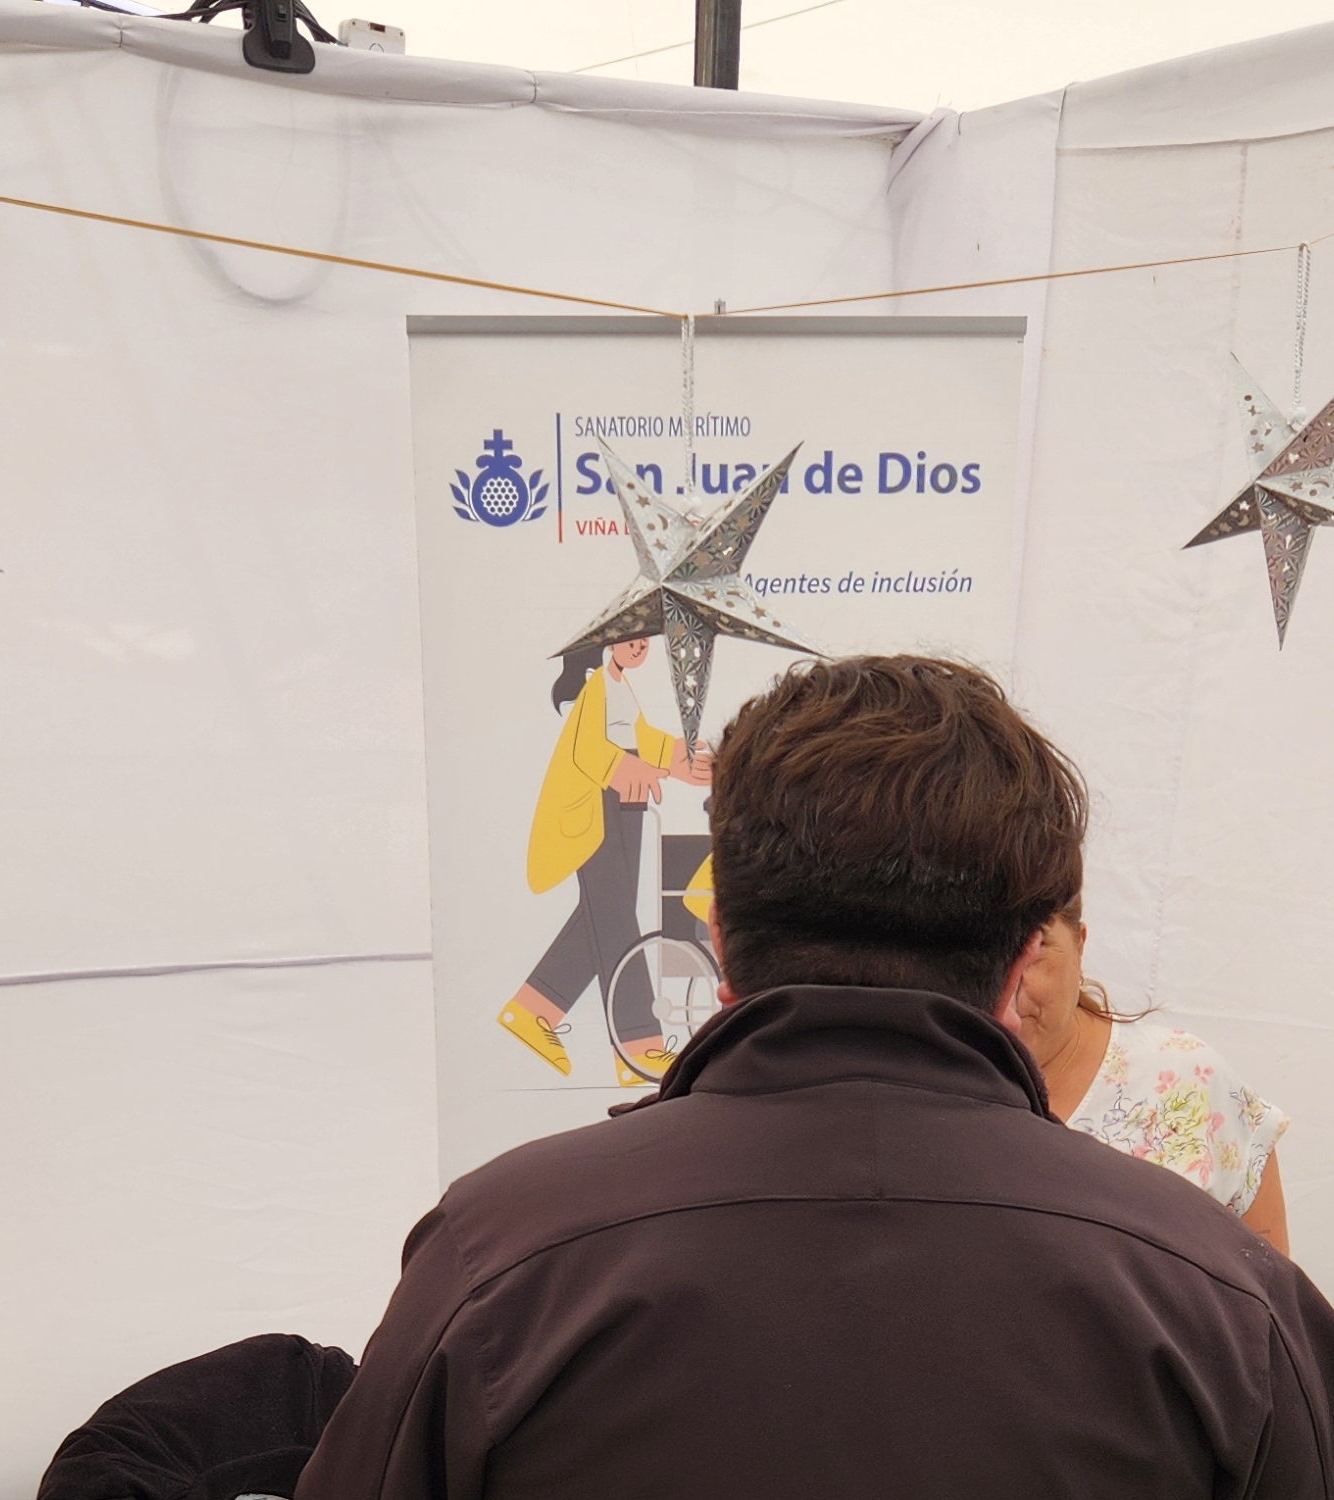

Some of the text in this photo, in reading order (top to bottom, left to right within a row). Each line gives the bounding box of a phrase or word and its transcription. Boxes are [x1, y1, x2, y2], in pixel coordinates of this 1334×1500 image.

[575, 412, 751, 437] SANATORIO MRÍTIMO
[803, 449, 863, 495] de
[878, 451, 982, 495] Dios
[576, 517, 619, 536] VIÑA
[744, 568, 973, 597] Agentes de inclusión
